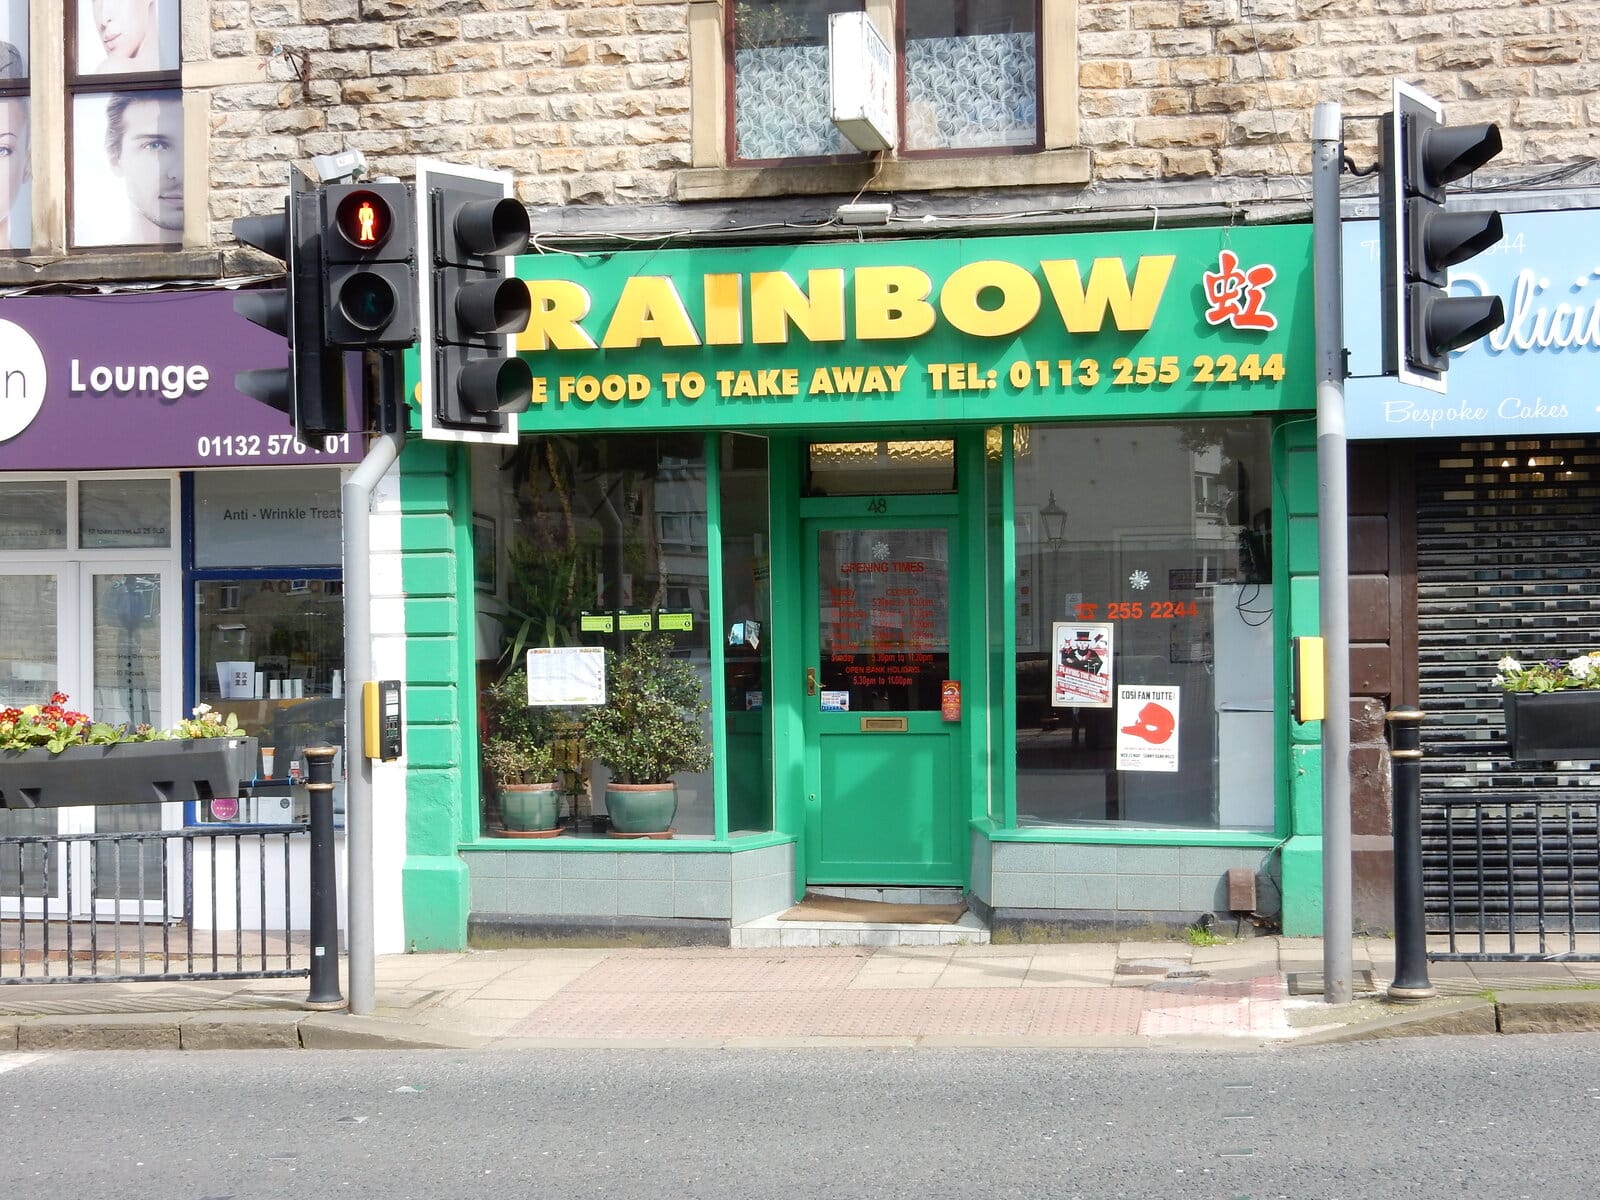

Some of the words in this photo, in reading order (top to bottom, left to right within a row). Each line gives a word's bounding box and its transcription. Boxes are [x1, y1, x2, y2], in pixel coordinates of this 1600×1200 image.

[515, 254, 1176, 351] RAINBOW
[1203, 249, 1277, 332] 虹
[71, 359, 209, 399] Lounge
[559, 373, 651, 403] FOOD
[662, 371, 706, 399] TO
[716, 368, 799, 397] TAKE
[809, 365, 908, 394] AWAY
[928, 363, 998, 391] TEL:
[1009, 357, 1099, 388] 0113
[1112, 355, 1180, 385] 255
[1192, 353, 1285, 383] 2244
[1384, 400, 1488, 430] Bespoke
[1498, 397, 1568, 420] Cakes
[198, 435, 261, 457] 01132
[267, 433, 350, 455] 57601
[223, 508, 248, 521] Anti
[259, 508, 306, 520] Wrinkle
[867, 498, 887, 513] 48
[840, 562, 889, 573] OPENING
[892, 561, 925, 573] TIMES
[1107, 602, 1143, 619] 255
[1150, 601, 1198, 619] 2244
[1137, 690, 1151, 700] FAN
